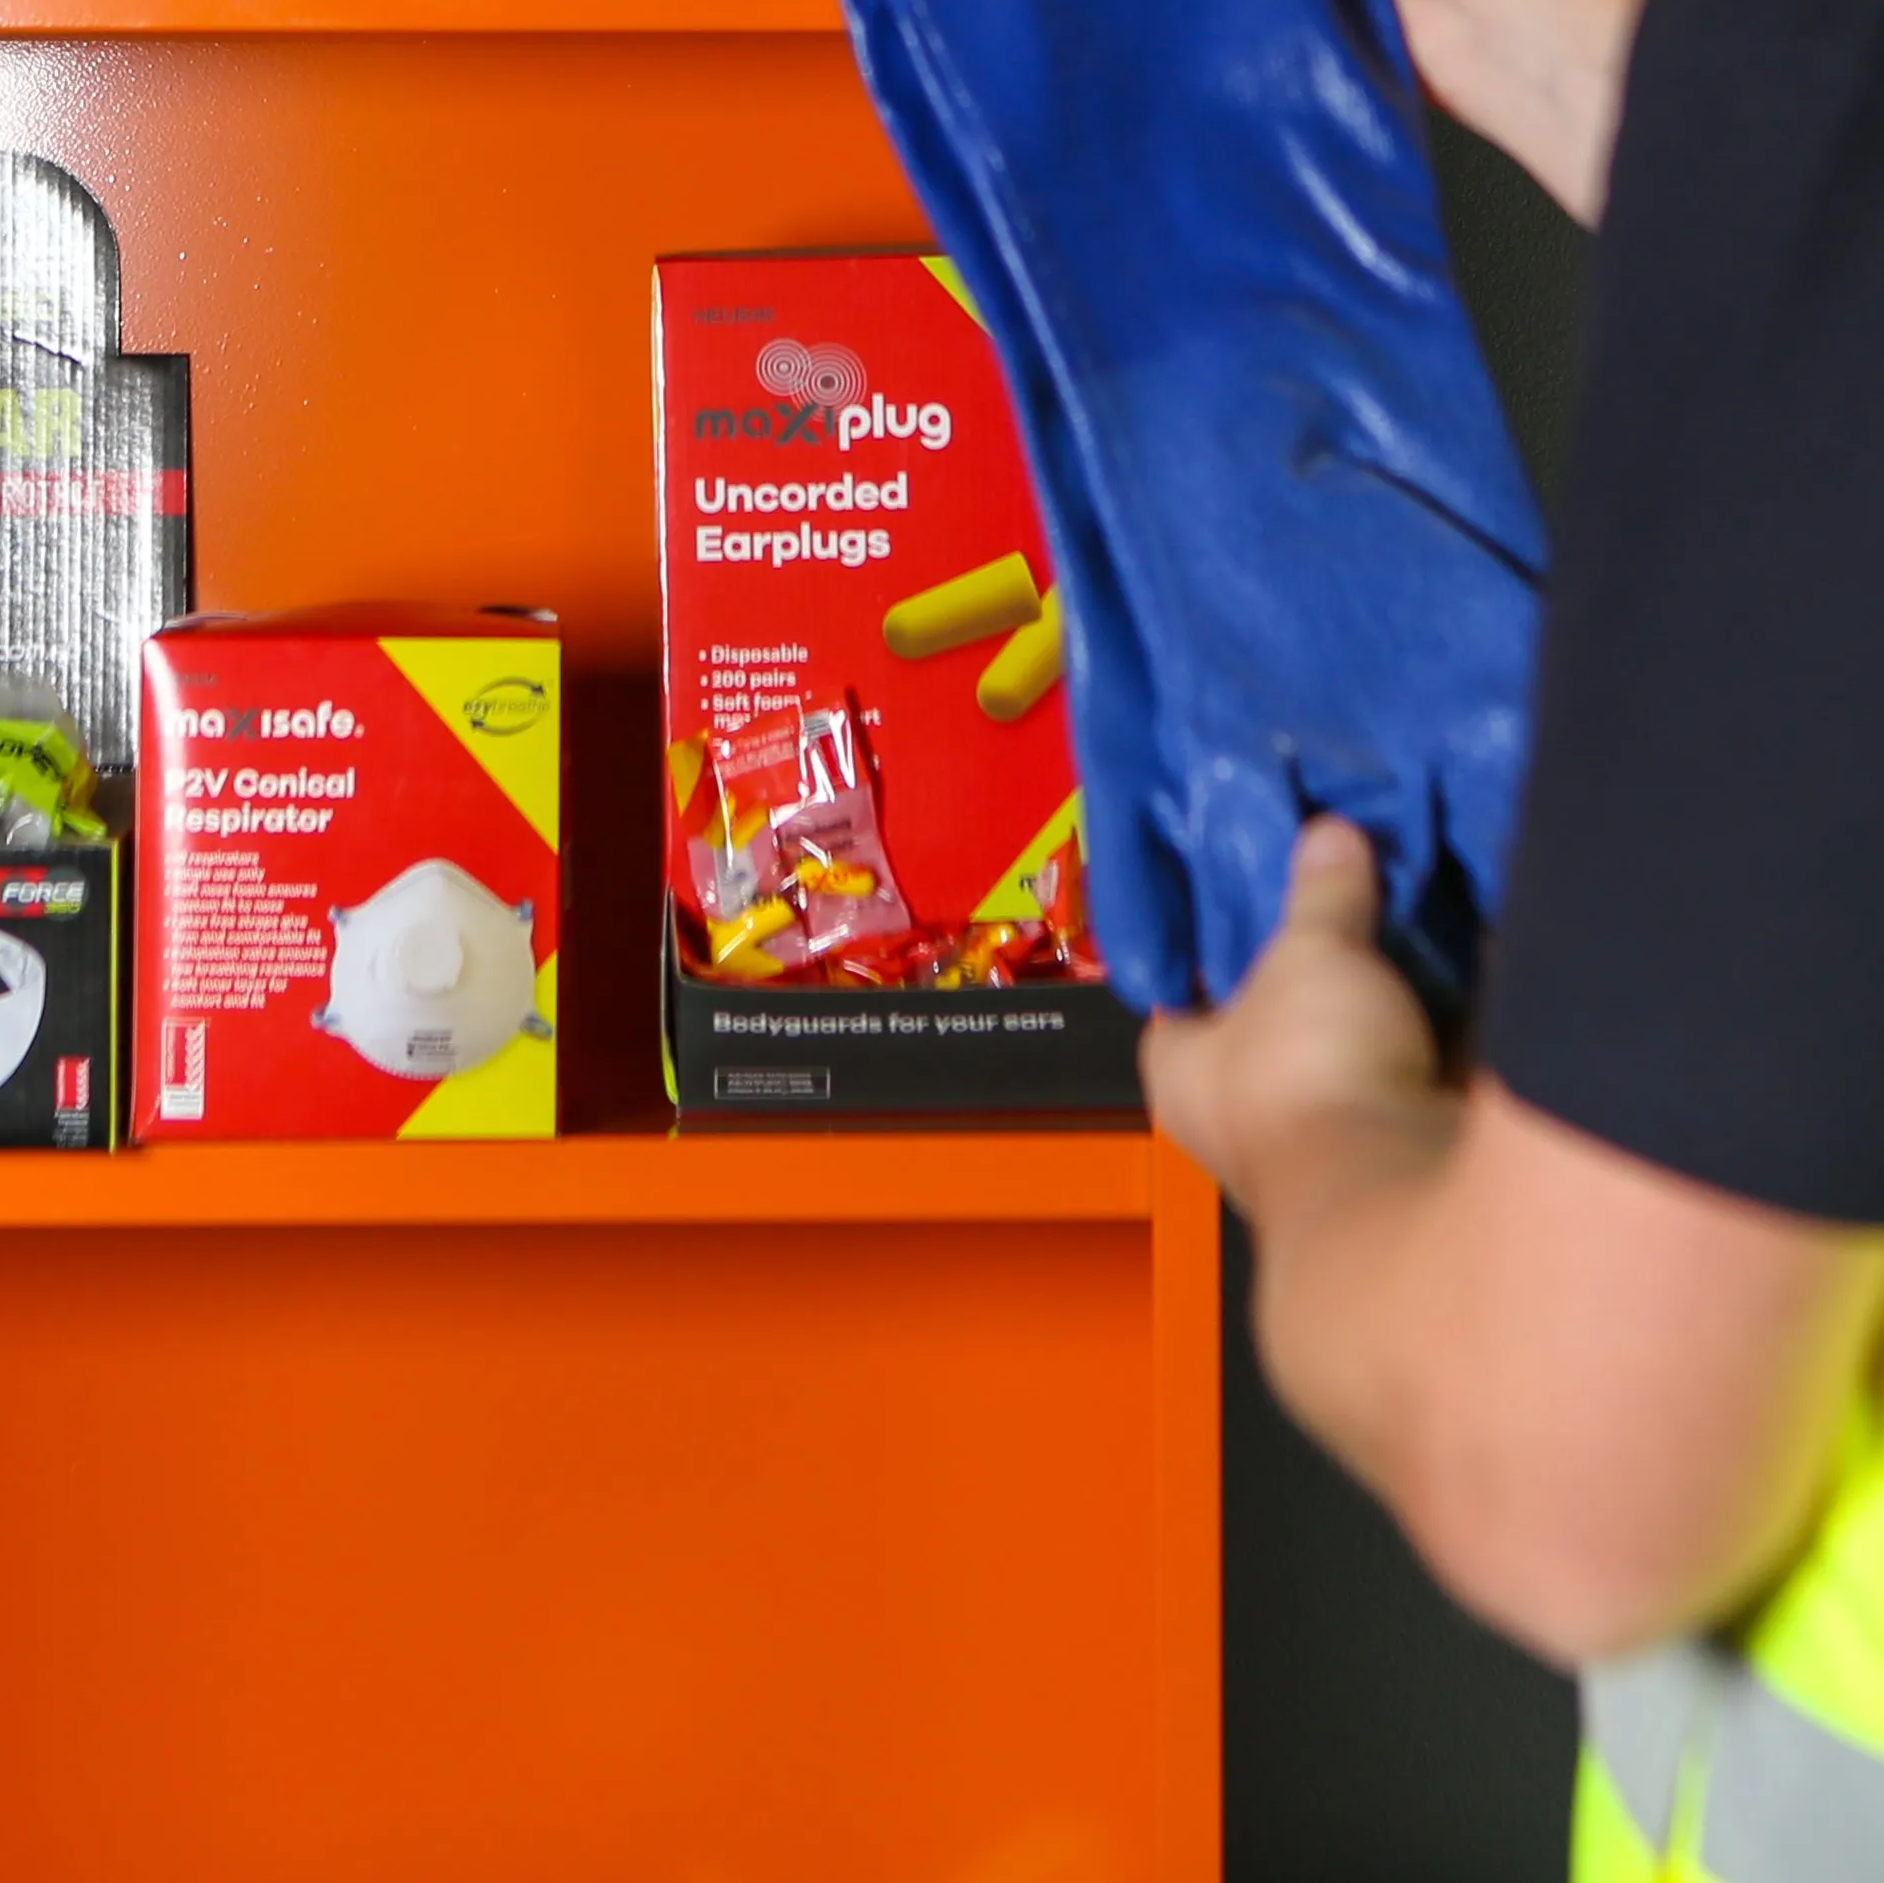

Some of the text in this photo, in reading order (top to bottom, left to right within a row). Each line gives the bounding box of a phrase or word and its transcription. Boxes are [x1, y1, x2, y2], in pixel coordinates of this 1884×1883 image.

[695, 393, 952, 452] maxiplug
[695, 472, 909, 514] Uncorded
[695, 522, 891, 568] Earplugs
[711, 644, 809, 667] Disposable
[712, 669, 797, 690] 200 pairs
[712, 693, 750, 711] Soft
[233, 765, 356, 799] Conical
[165, 801, 335, 838] Respirator
[2, 880, 86, 904] FORCE
[713, 1011, 1065, 1037] Bodyguards for your ears
